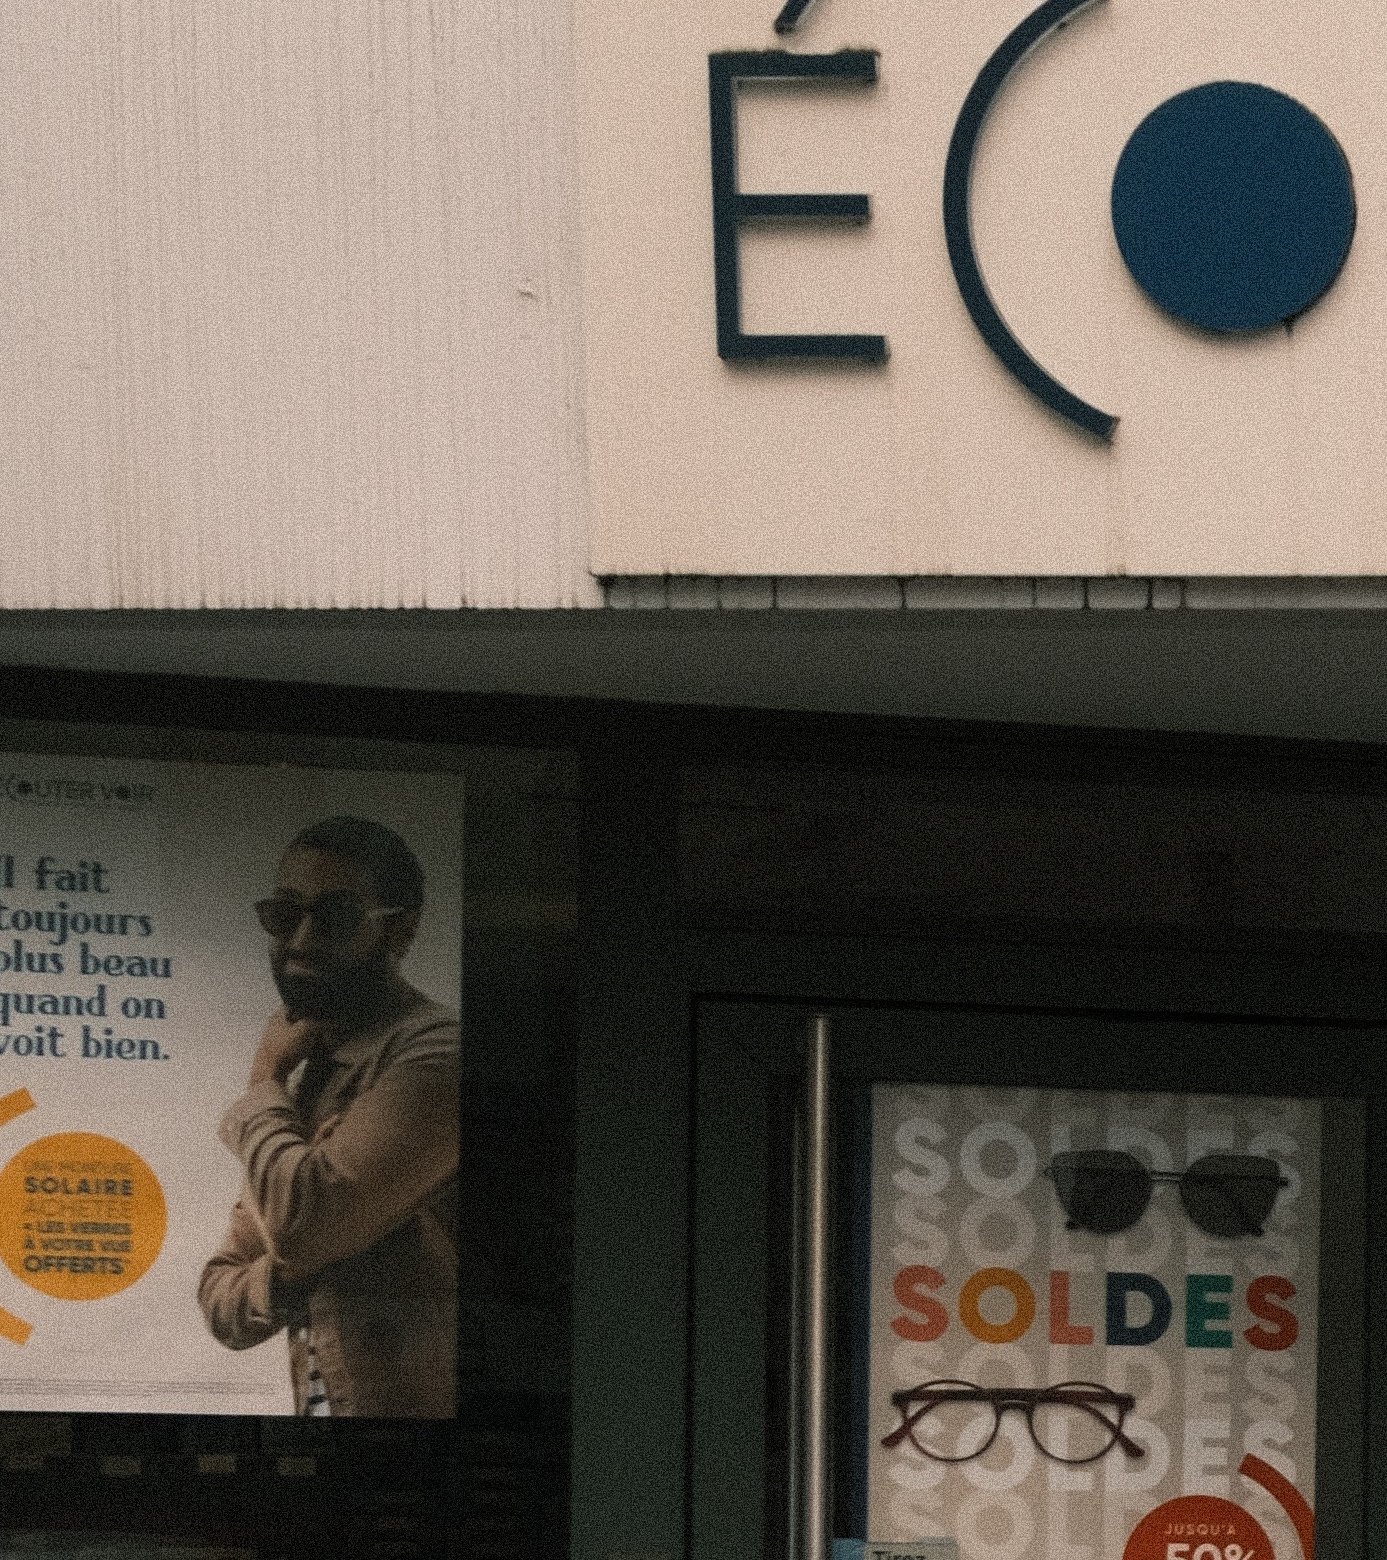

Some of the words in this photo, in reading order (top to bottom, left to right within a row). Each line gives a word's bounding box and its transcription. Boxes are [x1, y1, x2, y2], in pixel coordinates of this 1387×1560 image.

[0, 772, 95, 803] COUTER
[35, 856, 109, 893] fait
[80, 942, 172, 978] beau
[120, 996, 166, 1020] on
[81, 1025, 171, 1061] bien.
[24, 1176, 133, 1197] SOLAIRE
[889, 1264, 1299, 1352] SOLDES
